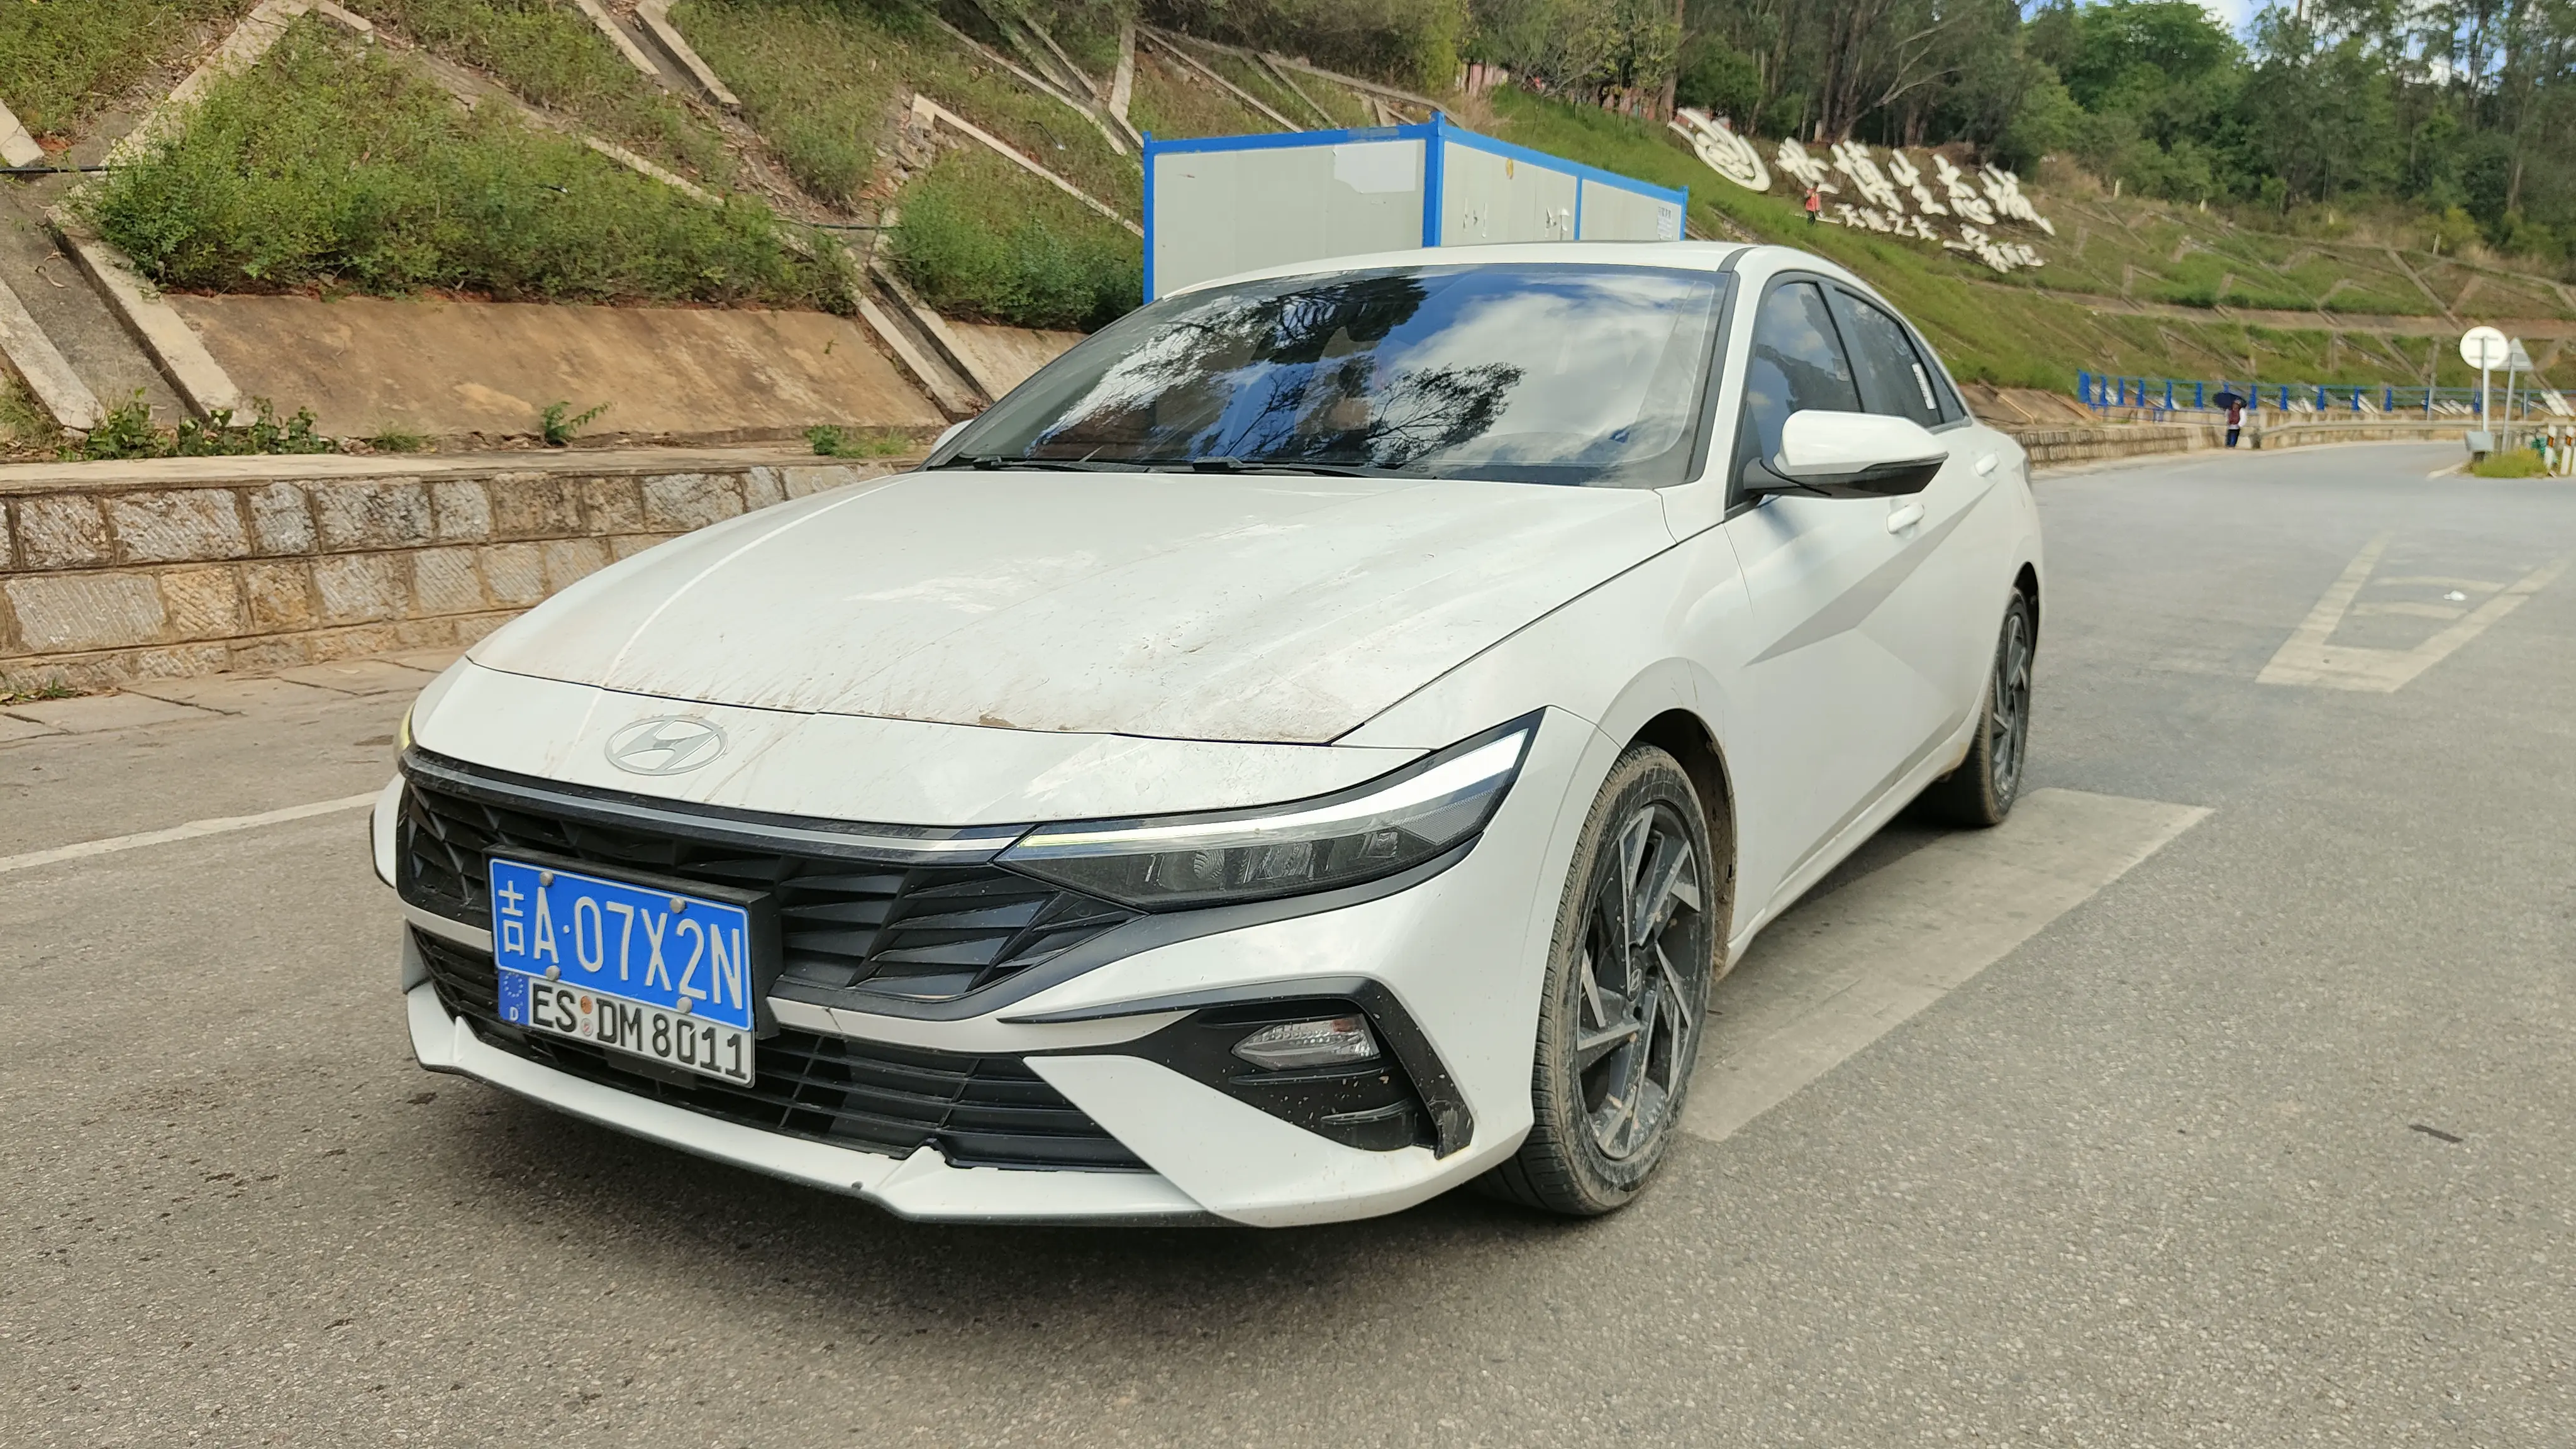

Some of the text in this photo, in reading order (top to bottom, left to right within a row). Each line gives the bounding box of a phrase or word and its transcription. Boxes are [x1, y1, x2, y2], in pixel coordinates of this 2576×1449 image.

[509, 1007, 519, 1021] D
[533, 983, 747, 1080] ES DM 8011
